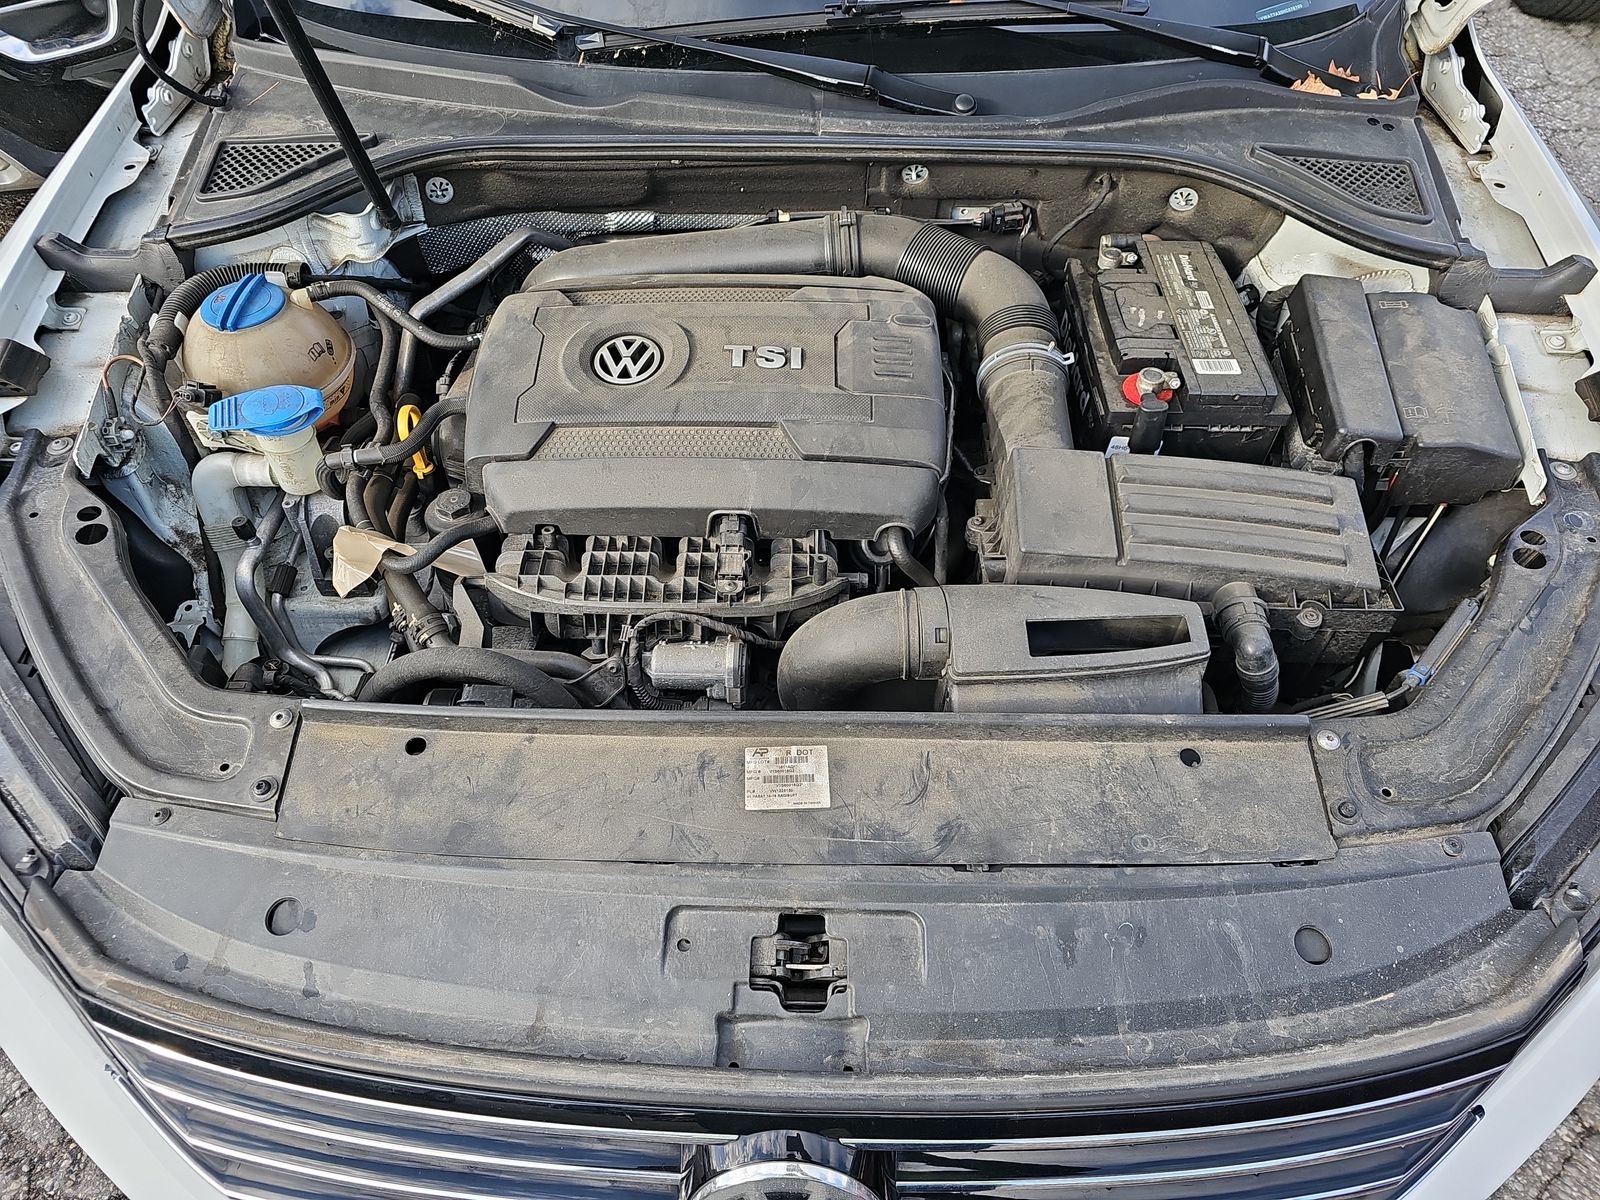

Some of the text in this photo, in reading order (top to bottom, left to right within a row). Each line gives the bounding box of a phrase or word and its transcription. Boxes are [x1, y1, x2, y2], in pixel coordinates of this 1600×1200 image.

[1179, 254, 1198, 281] DieHard
[724, 345, 803, 369] TSI
[796, 748, 813, 756] DOT
